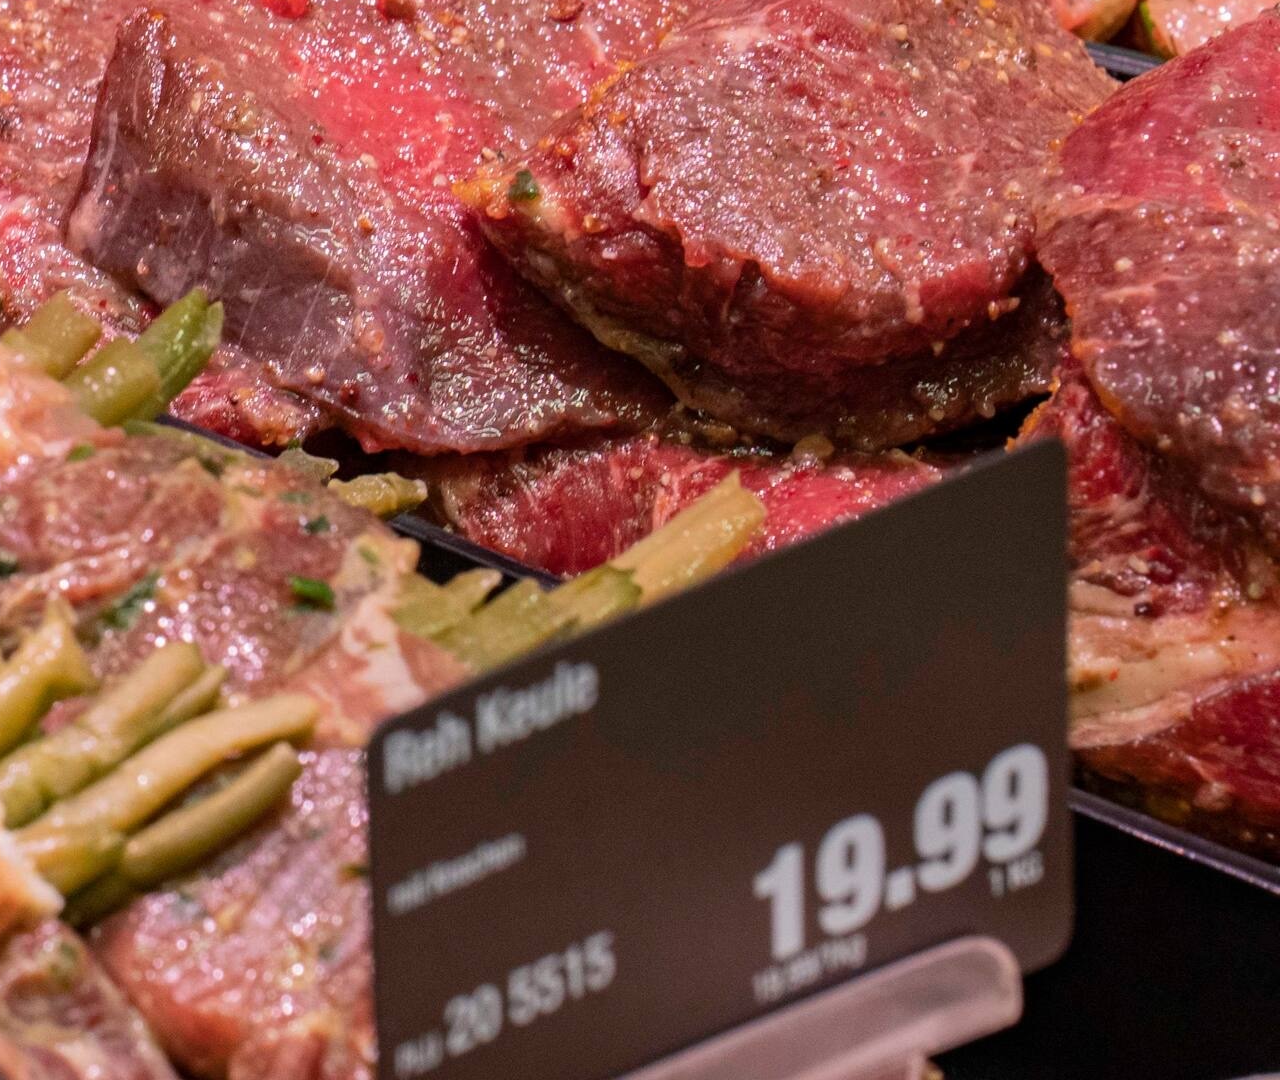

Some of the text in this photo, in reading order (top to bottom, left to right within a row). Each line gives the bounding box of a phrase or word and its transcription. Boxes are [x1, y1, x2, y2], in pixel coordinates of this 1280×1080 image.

[753, 744, 1049, 962] 19.99
[445, 985, 502, 1055] 20
[507, 931, 616, 1025] 5515
